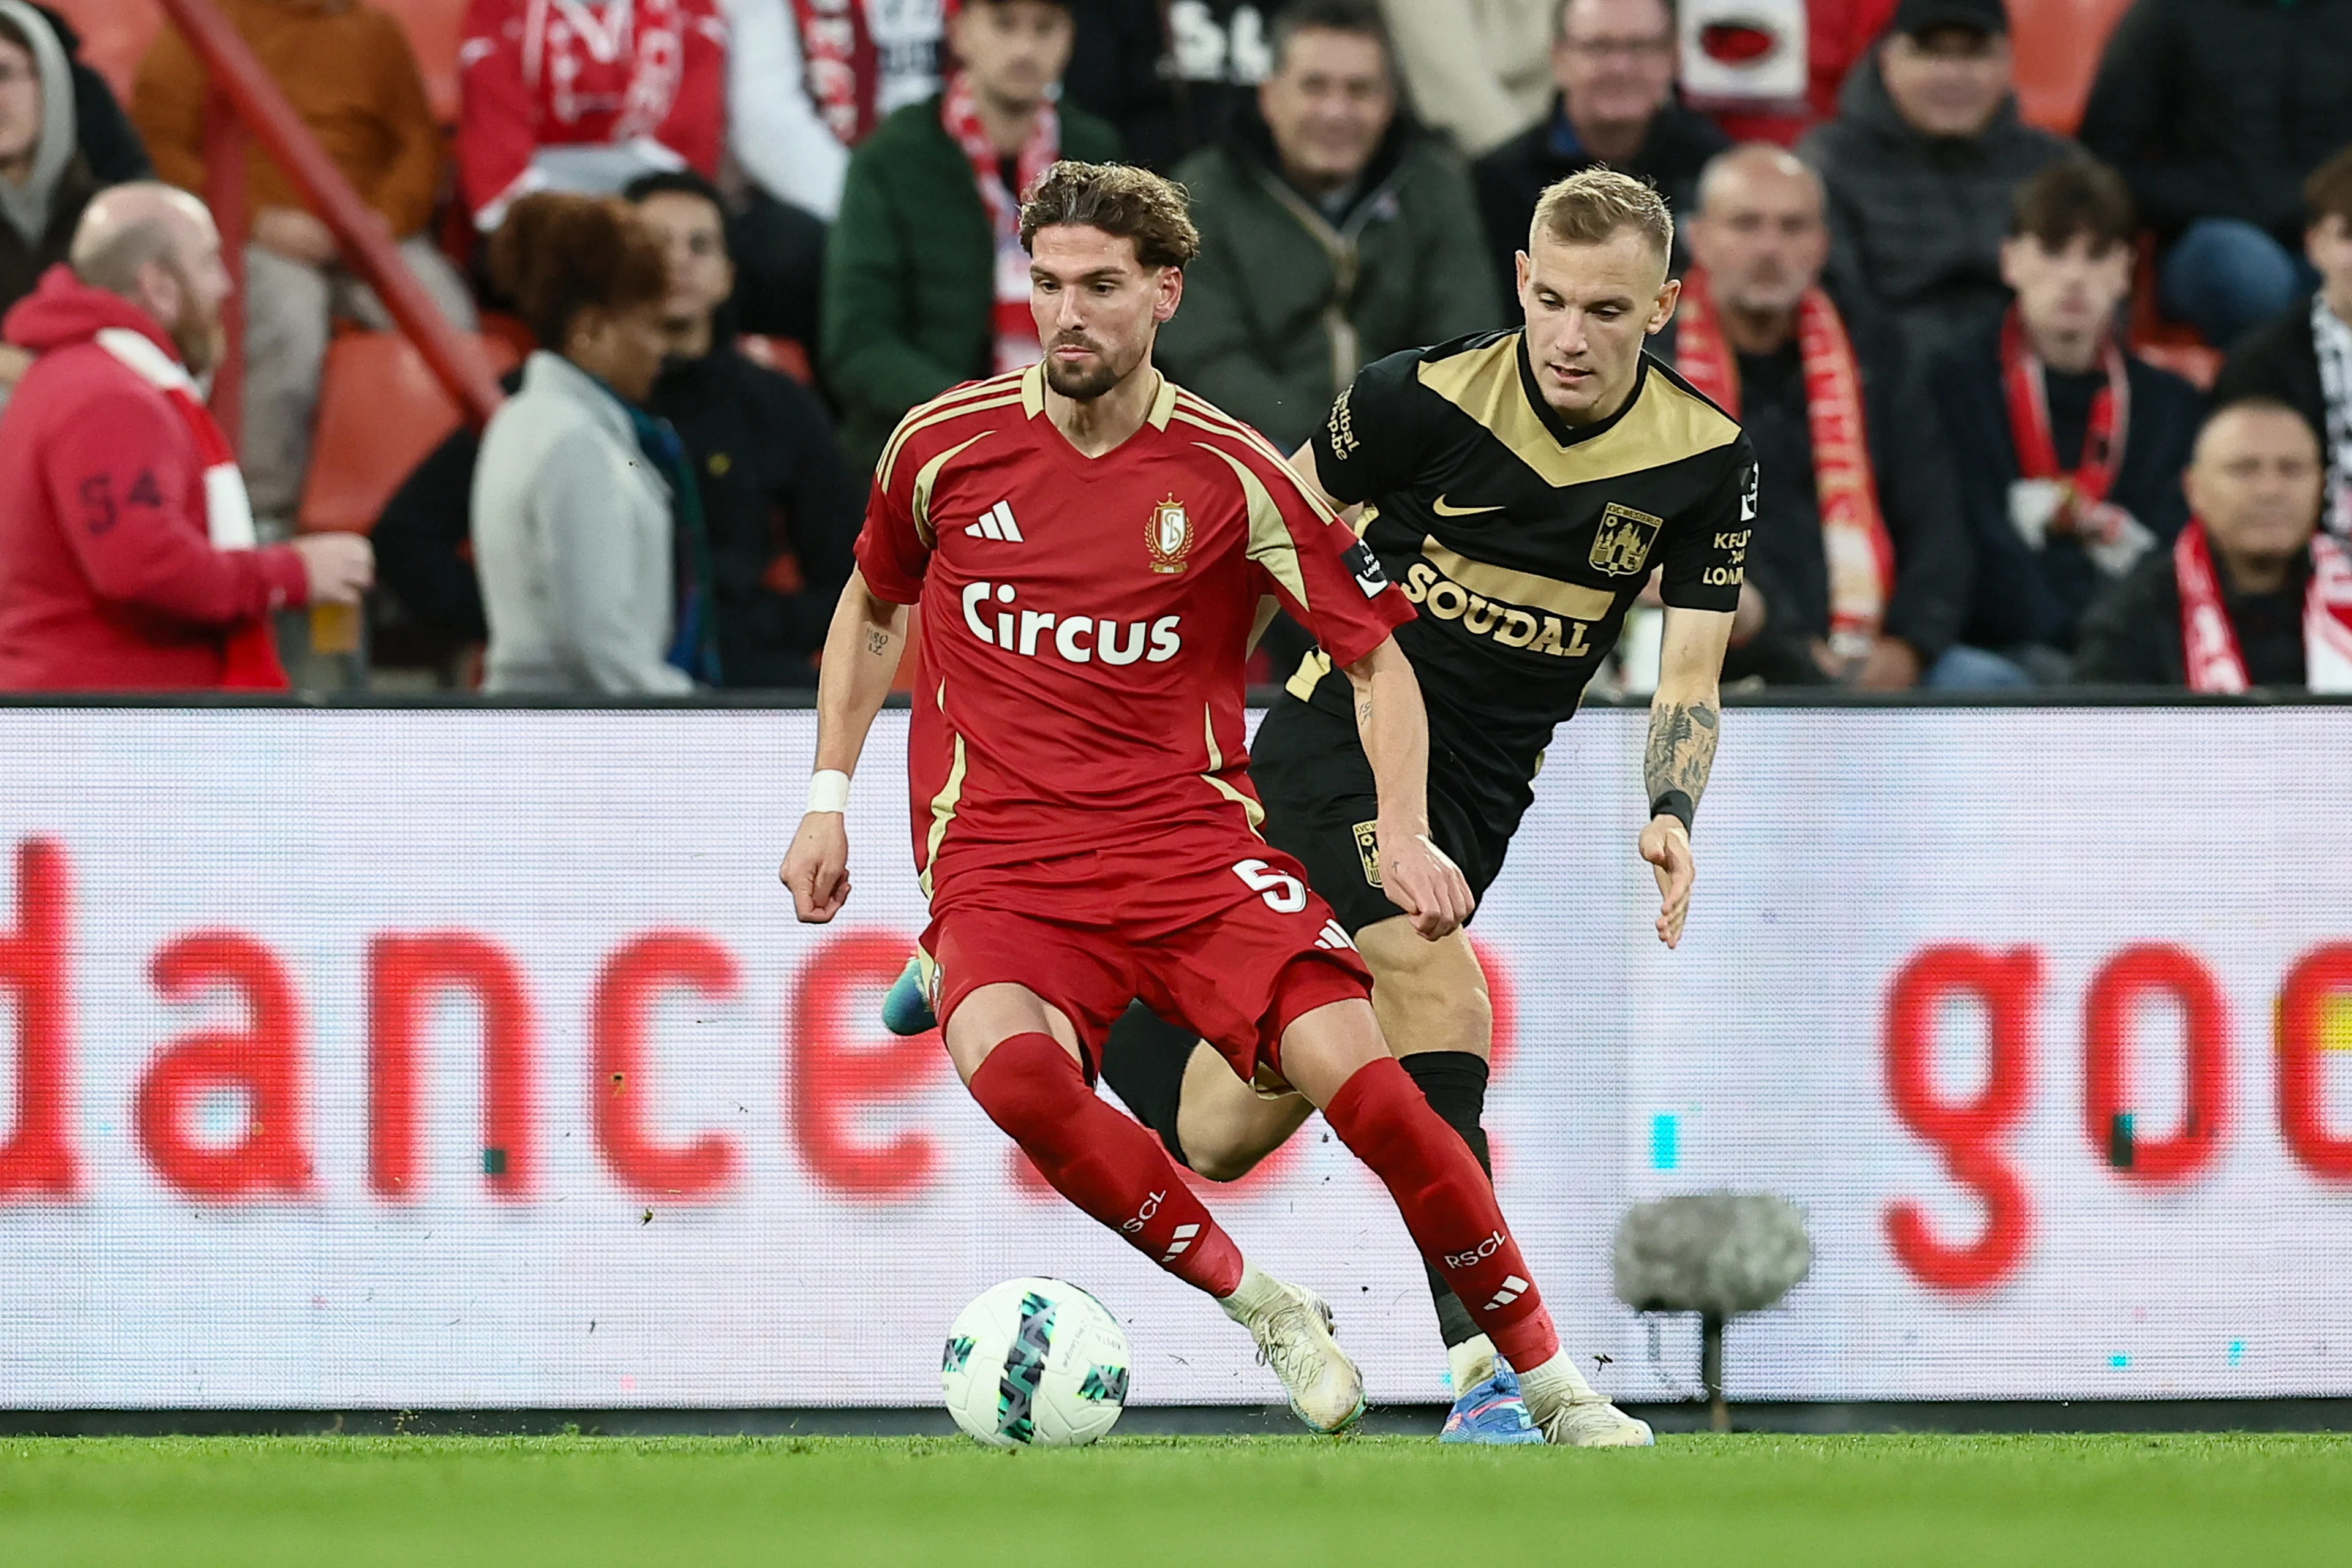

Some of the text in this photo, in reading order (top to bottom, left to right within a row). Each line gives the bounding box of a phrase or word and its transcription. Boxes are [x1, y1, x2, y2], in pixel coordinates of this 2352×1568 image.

[80, 468, 163, 535] 54
[962, 581, 1182, 665] Circus
[1400, 563, 1591, 657] SOUDAL
[1232, 859, 1307, 914] 5
[1112, 1190, 1167, 1233] SCL
[1444, 1230, 1507, 1269] RSCL
